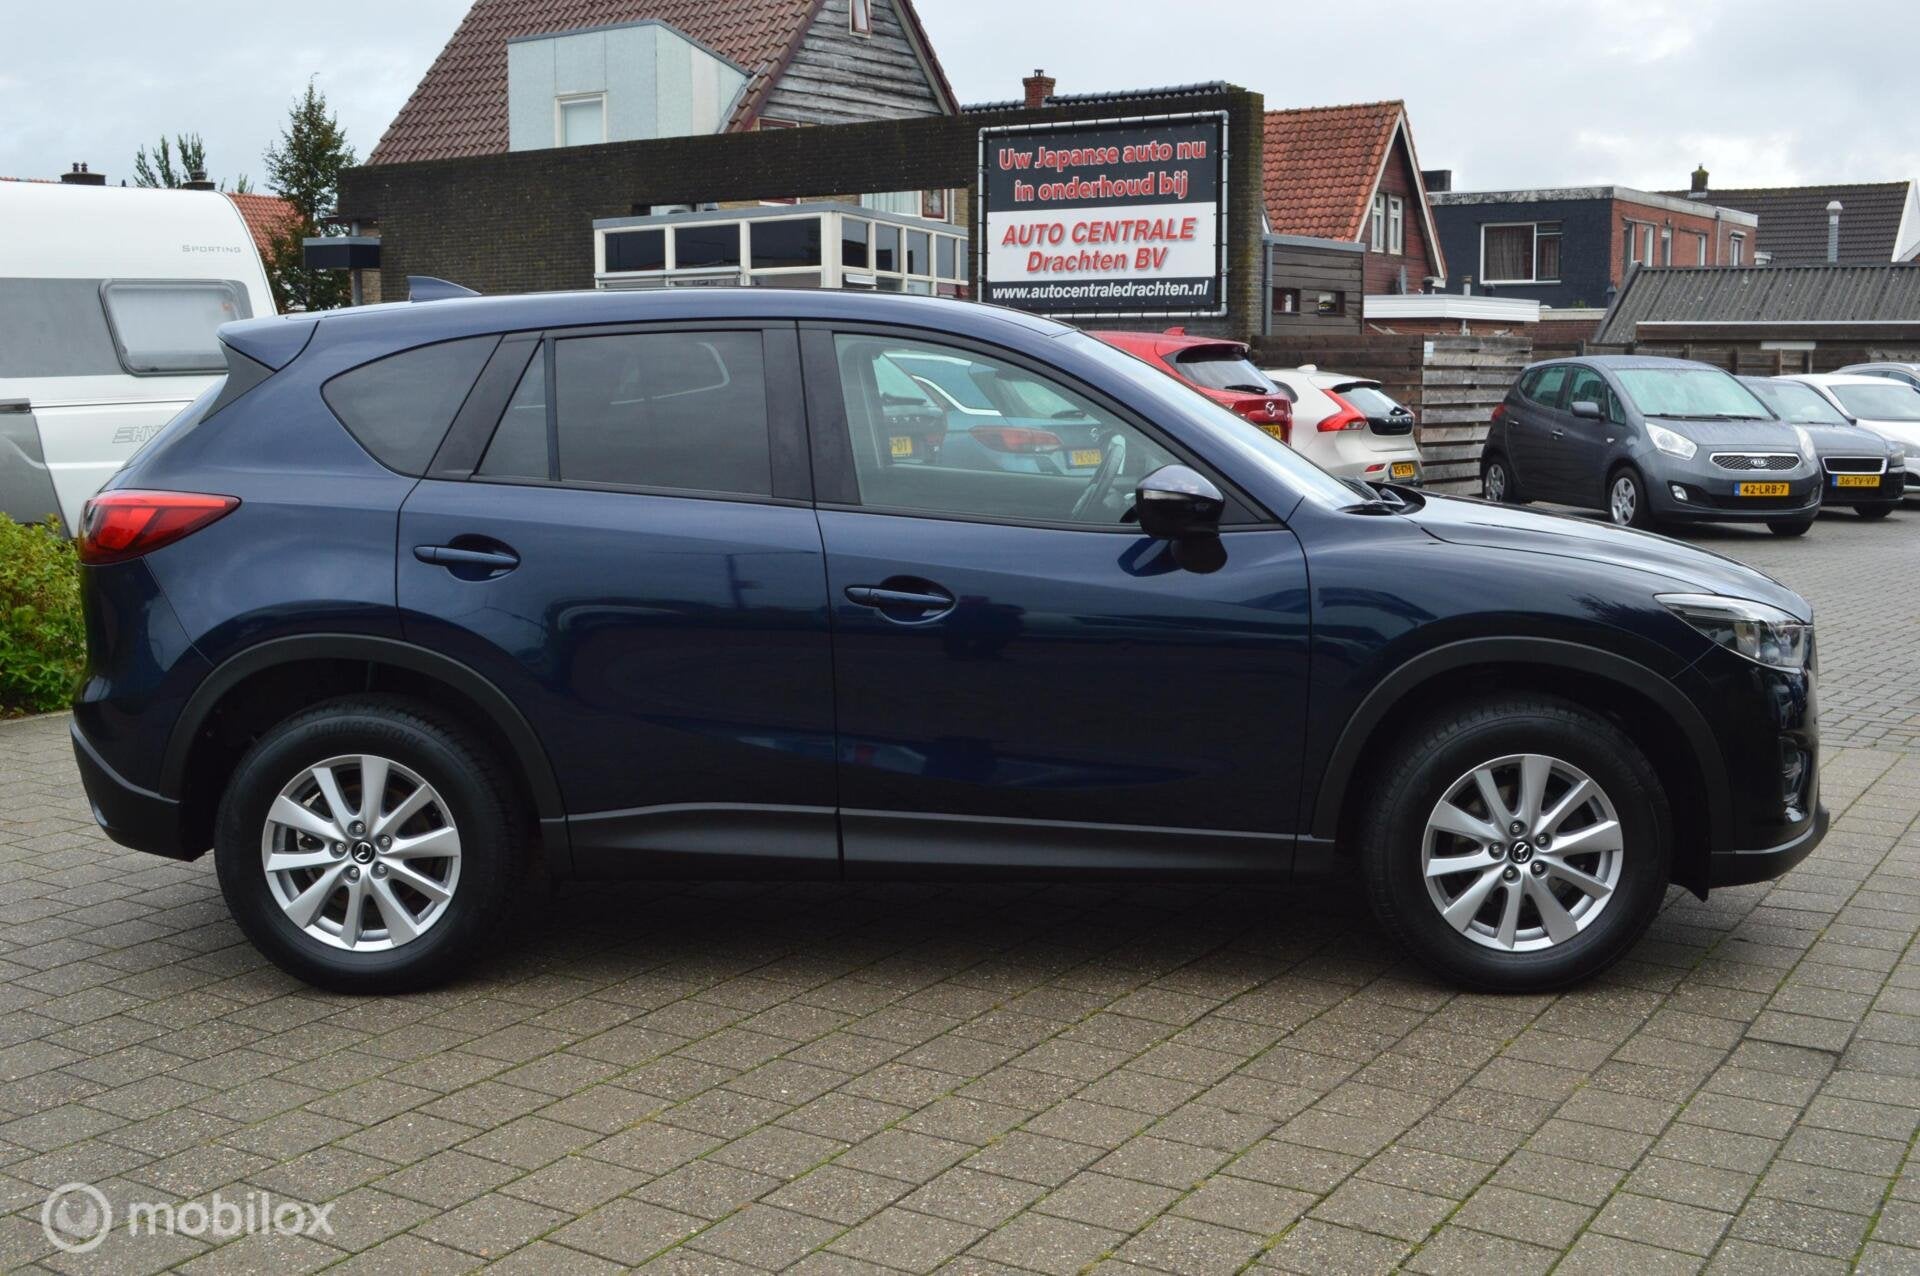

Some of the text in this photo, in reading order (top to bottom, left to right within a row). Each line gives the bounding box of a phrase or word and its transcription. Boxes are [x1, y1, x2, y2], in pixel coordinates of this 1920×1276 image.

[999, 140, 1207, 172] Uw Japanse auto nu
[1014, 170, 1189, 202] in onderhoud bij
[1001, 217, 1197, 246] AUTO CENTRALE
[1026, 246, 1169, 273] Drachten BV
[992, 280, 1209, 300] www.autocentraledrachten.nl
[1743, 484, 1786, 495] 42-LRB-7
[1839, 476, 1878, 486] 36-TV-VP
